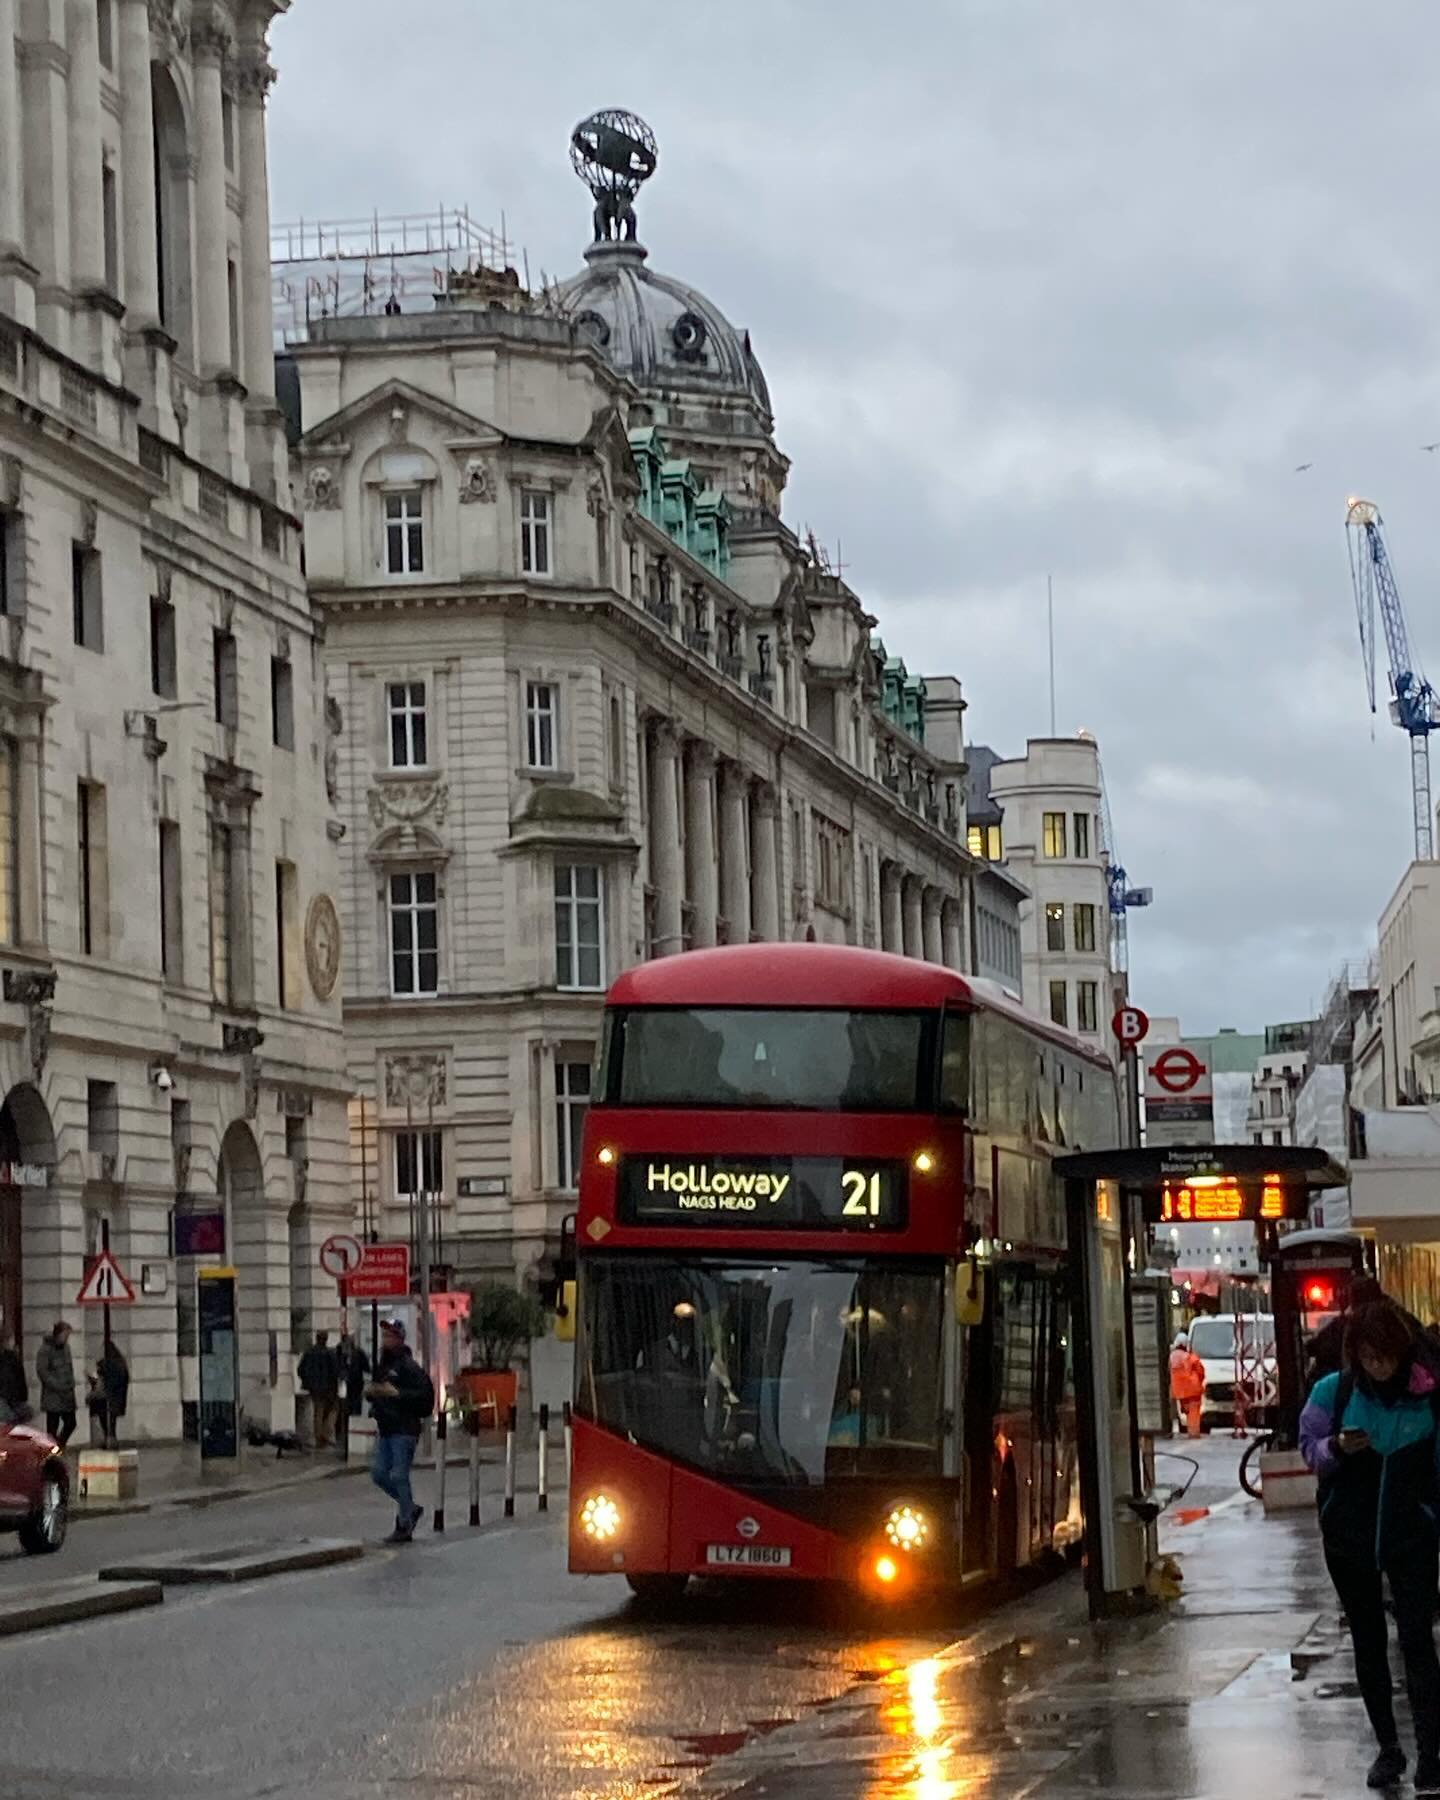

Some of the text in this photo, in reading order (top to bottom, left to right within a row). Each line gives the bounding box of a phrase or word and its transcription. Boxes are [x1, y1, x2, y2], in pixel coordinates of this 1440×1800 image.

[1122, 1012, 1140, 1038] B
[648, 1164, 789, 1202] Holloway
[842, 1171, 880, 1215] 21
[679, 1196, 756, 1210] NAGS HEAD
